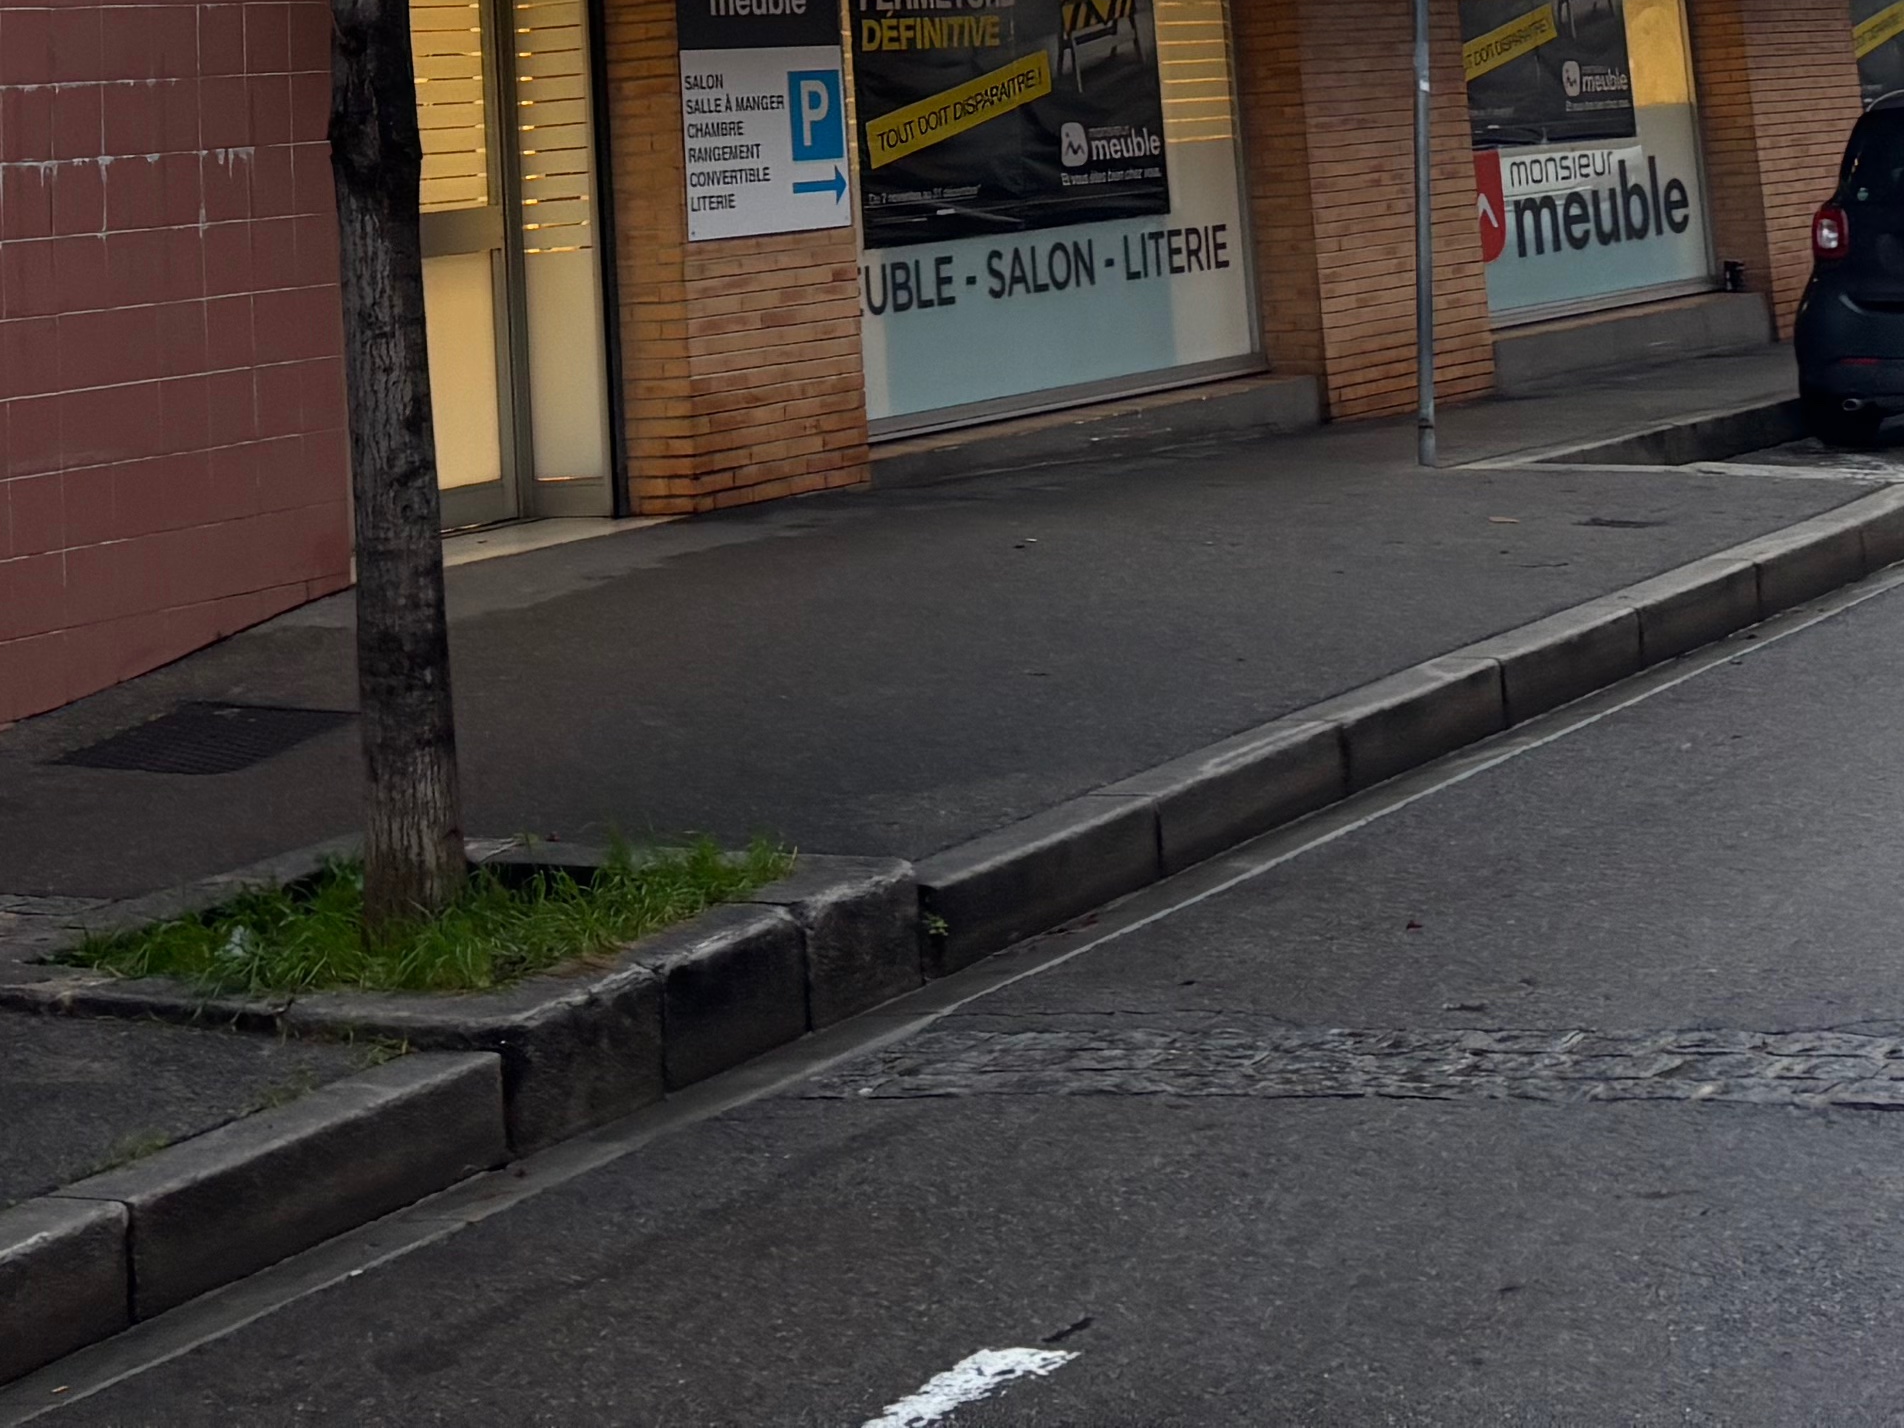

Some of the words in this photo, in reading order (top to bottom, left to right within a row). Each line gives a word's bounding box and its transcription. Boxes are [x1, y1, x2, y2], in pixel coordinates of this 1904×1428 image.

[860, 9, 1002, 52] DÉFINITIVE
[684, 73, 725, 91] SALON
[685, 97, 723, 115] SALLE
[735, 94, 786, 113] MANGER
[687, 120, 745, 140] CHAMBRE
[876, 119, 915, 152] TOUT
[917, 104, 951, 136] DOIT
[688, 142, 763, 164] RANGEMENT
[1090, 126, 1162, 161] meuble
[689, 165, 772, 188] CONVERTIBLE
[1509, 150, 1614, 188] monsieur
[690, 192, 737, 213] LITERIE
[1512, 154, 1690, 258] meuble
[986, 238, 1096, 300] SALON
[1123, 223, 1231, 281] LITERIE
